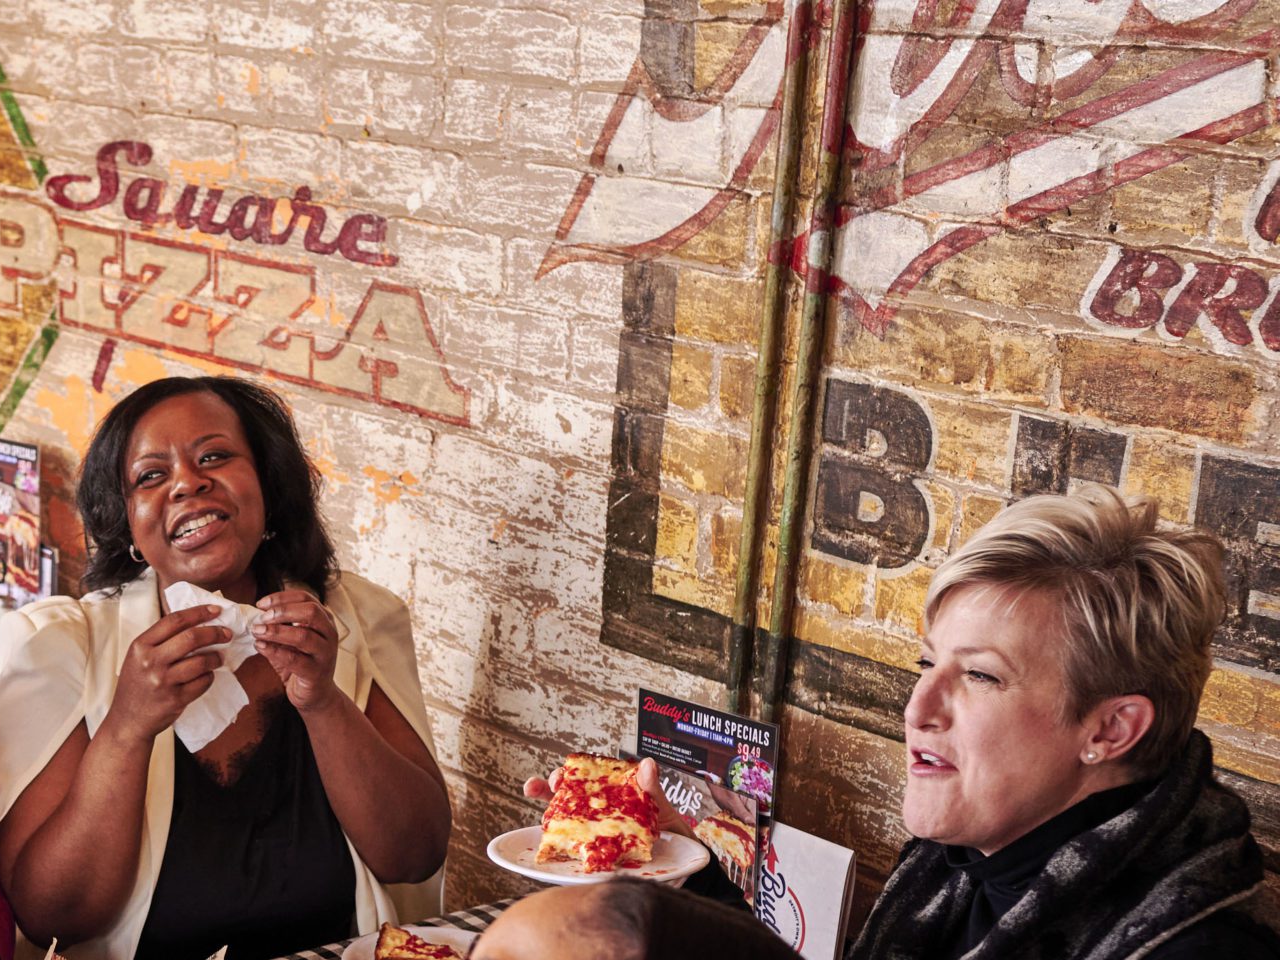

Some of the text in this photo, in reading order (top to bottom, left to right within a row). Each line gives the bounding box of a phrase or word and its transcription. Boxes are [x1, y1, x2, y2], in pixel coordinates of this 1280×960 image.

[642, 696, 691, 723] Buddy's
[691, 709, 721, 733] LUNCH
[724, 719, 770, 747] SPECIALS
